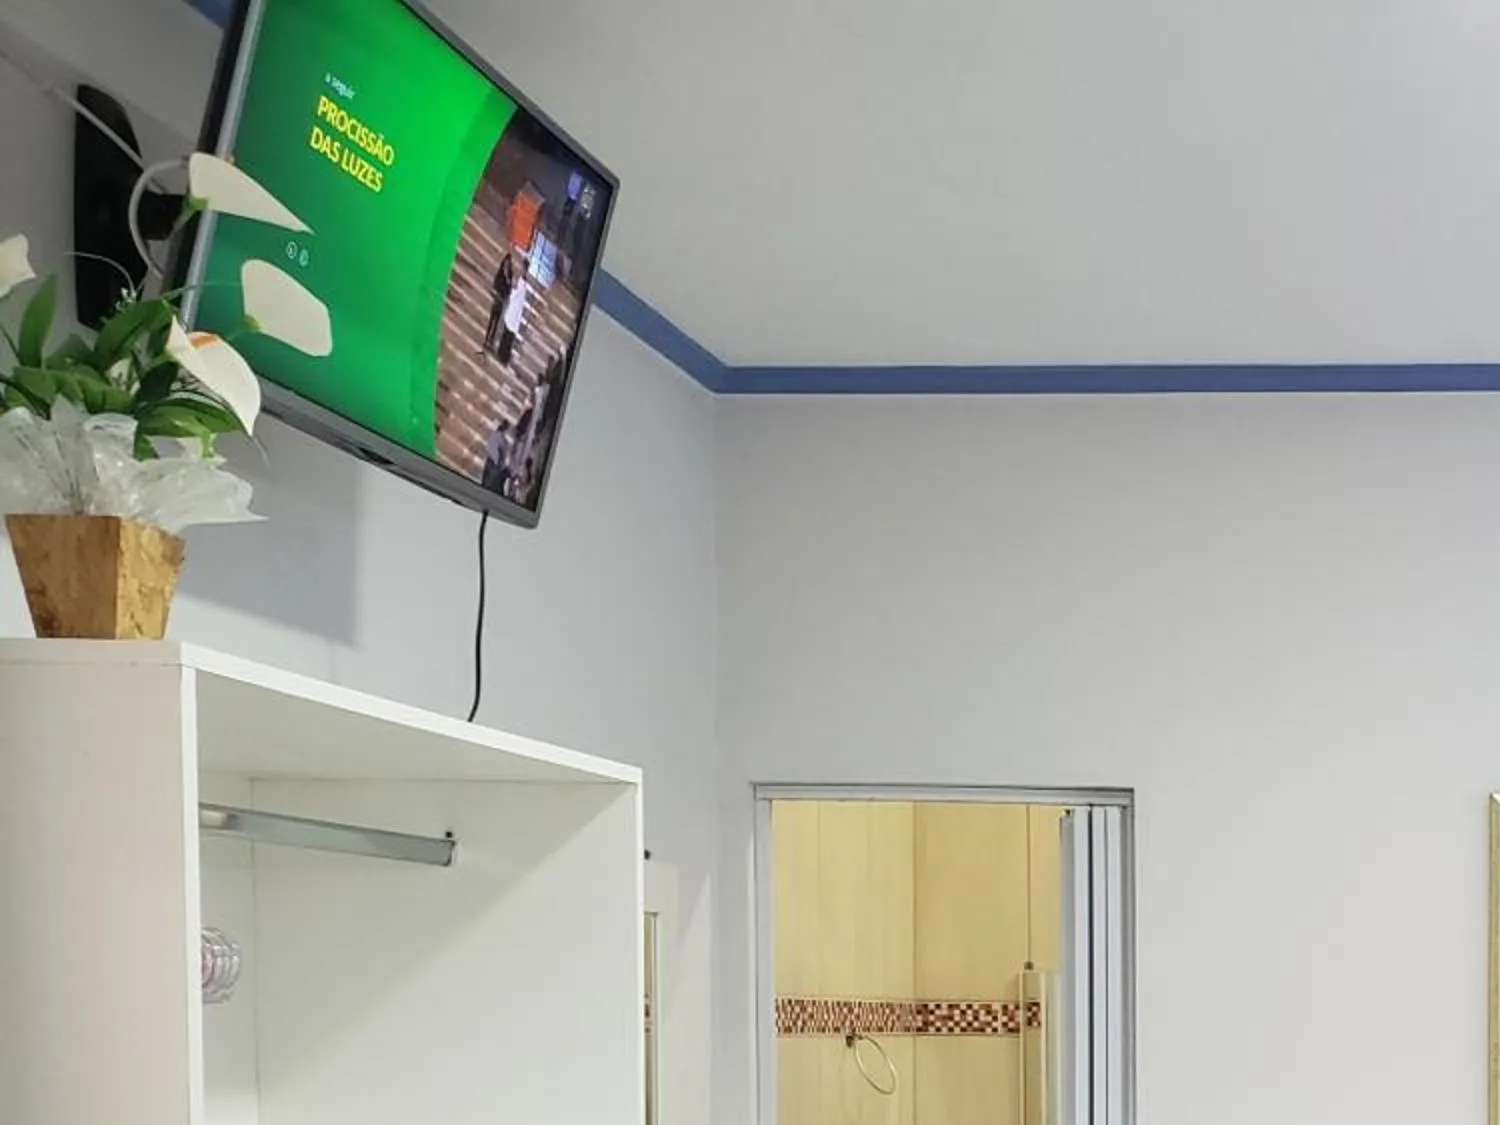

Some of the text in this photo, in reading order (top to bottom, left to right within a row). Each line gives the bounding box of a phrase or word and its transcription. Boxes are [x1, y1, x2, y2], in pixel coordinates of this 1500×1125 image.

[309, 125, 384, 192] DAS LUZES
[317, 95, 395, 166] PROCISSÃO
